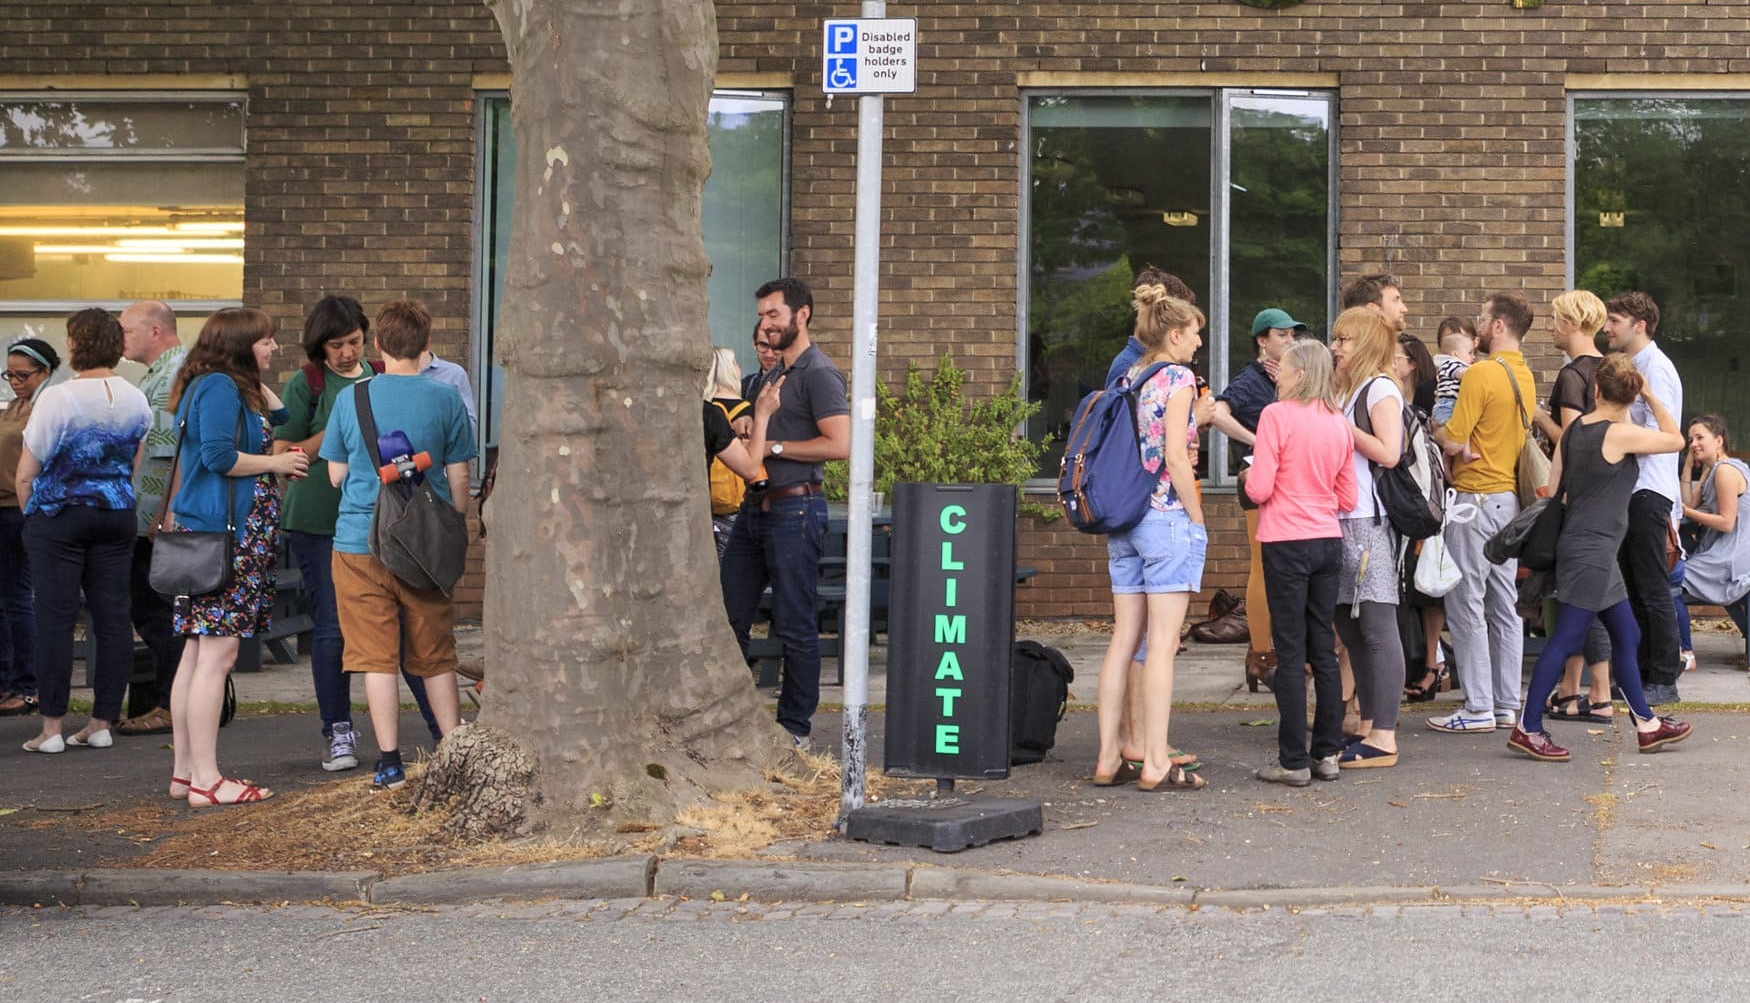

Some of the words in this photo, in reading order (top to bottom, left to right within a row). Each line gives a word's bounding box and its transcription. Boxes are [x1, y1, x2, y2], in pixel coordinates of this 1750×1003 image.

[834, 26, 854, 53] P
[862, 32, 911, 42] Disabled
[868, 45, 903, 55] badge
[864, 58, 907, 67] holders
[873, 69, 897, 80] only
[934, 505, 967, 755] CLIMATE
